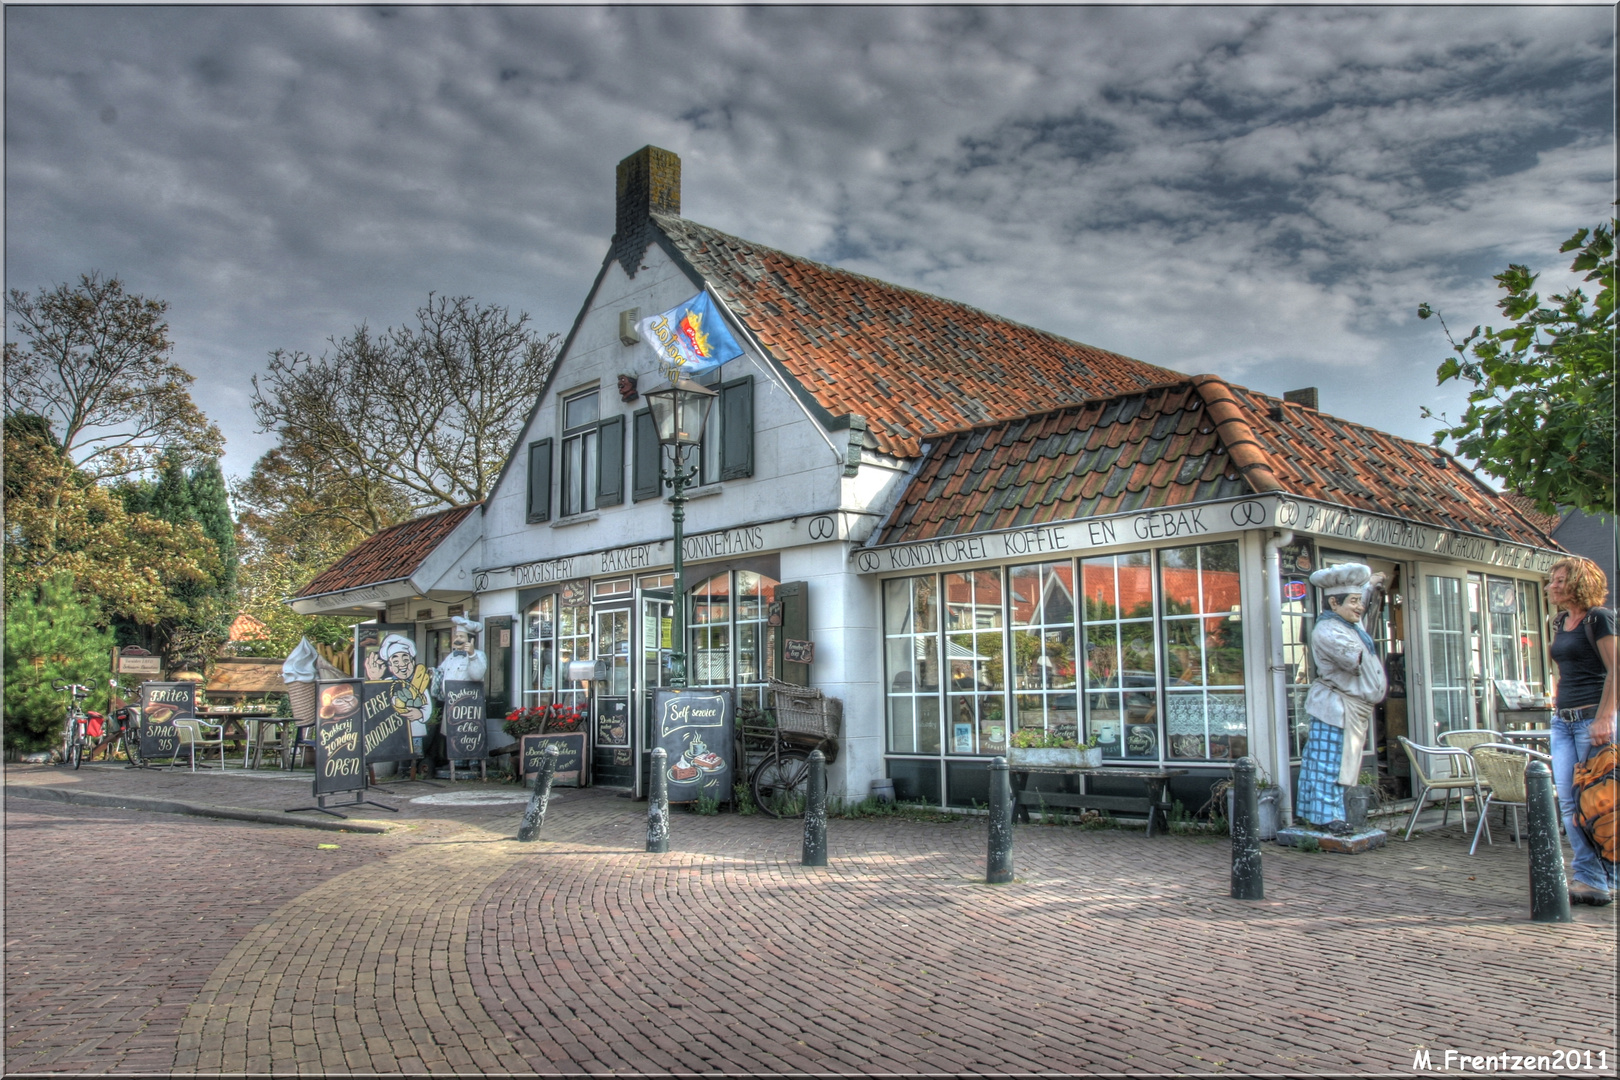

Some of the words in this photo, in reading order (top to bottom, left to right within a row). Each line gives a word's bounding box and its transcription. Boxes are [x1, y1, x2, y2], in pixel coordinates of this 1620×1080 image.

[1304, 505, 1361, 540] BAKKERY
[1364, 517, 1428, 550] SONNEMANS
[889, 537, 988, 569] KONDITOREI
[1004, 526, 1069, 556] KOFFIE
[1089, 519, 1116, 546] EN
[1134, 508, 1208, 540] GEBAK
[516, 558, 575, 586] DROGISTERY
[601, 544, 651, 573] BAKKERY
[682, 527, 764, 561] SONNEMANS
[364, 690, 391, 722] ERSE
[452, 705, 482, 720] OPEN
[670, 704, 690, 723] Self
[691, 708, 717, 718] service
[457, 722, 479, 733] elke
[460, 733, 482, 751] dag!
[325, 757, 360, 777] OPEN
